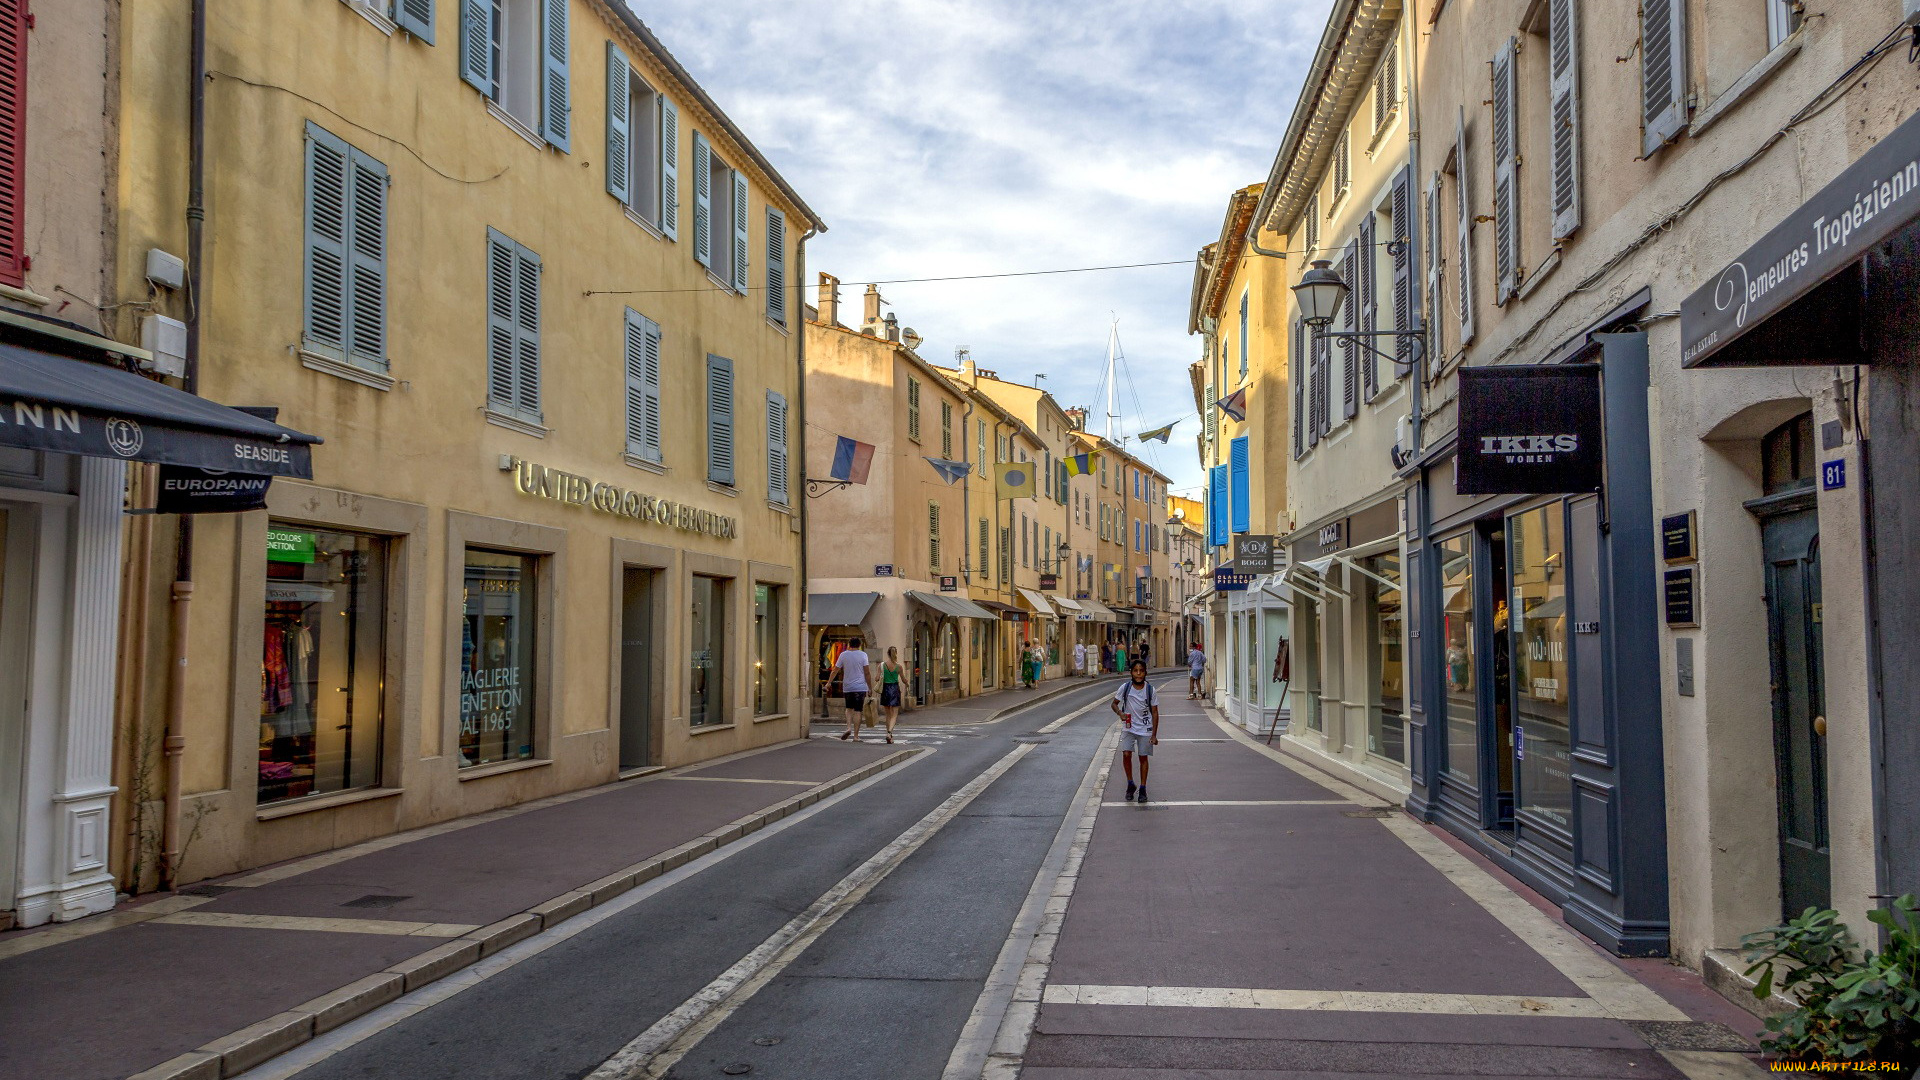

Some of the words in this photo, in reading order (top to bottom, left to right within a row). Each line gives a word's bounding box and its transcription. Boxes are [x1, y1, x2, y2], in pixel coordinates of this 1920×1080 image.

[1714, 242, 1809, 328] Demeures
[1683, 344, 1697, 363] REAL
[1697, 330, 1718, 355] ESTATE
[0, 400, 81, 434] NN
[234, 443, 290, 464] SEASIDE
[1480, 434, 1578, 454] IKKS
[1506, 455, 1552, 464] WOMEN
[164, 479, 266, 491] EUROPANN
[1826, 465, 1840, 485] 81
[517, 460, 594, 506] UNITED
[593, 482, 657, 522] COLORS
[657, 499, 679, 526] OF
[678, 503, 738, 540] BENETTON
[266, 541, 296, 551] ENETTON.
[276, 533, 302, 543] COLORS
[1547, 641, 1563, 662] IKKS
[460, 687, 522, 713] ENETTON
[483, 710, 512, 733] 1965
